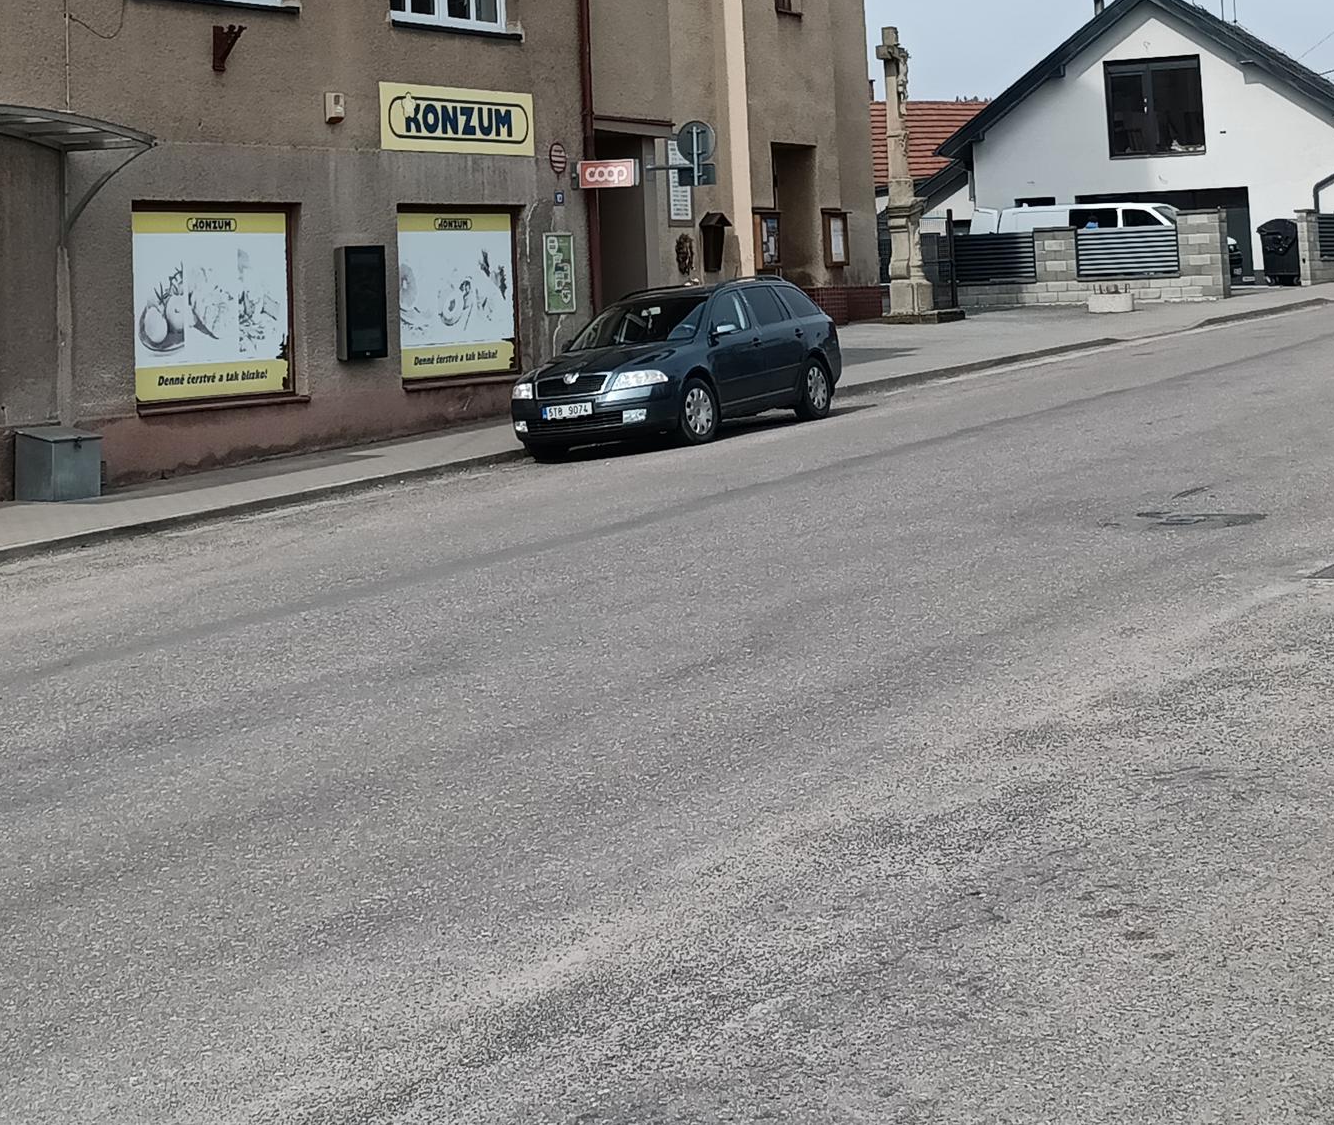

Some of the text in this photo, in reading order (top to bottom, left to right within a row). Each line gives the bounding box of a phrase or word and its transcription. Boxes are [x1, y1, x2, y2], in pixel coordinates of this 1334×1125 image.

[404, 103, 513, 138] KONZUM
[585, 165, 628, 184] coop
[192, 219, 232, 230] KONZUM
[218, 374, 224, 382] a
[226, 371, 239, 382] tak
